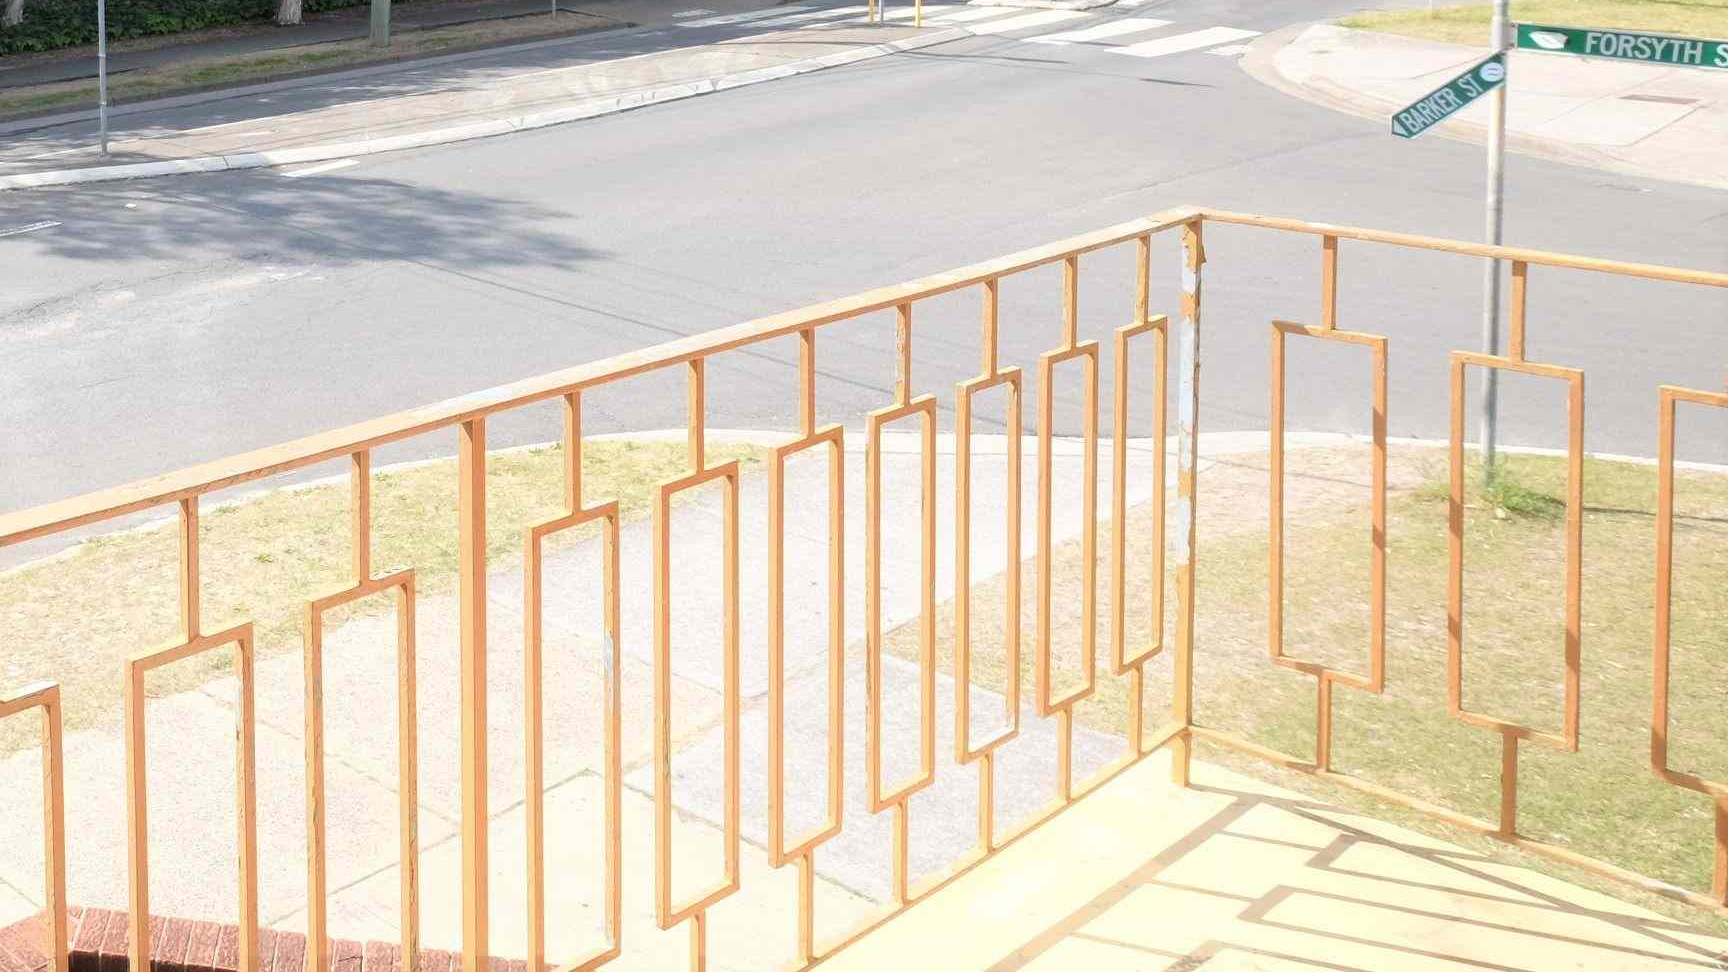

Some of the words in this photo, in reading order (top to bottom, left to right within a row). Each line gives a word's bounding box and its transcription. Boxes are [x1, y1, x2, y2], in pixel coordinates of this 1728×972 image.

[1585, 32, 1703, 64] FORSYTH
[1399, 88, 1463, 132] BARKER
[1458, 73, 1484, 96] ST
